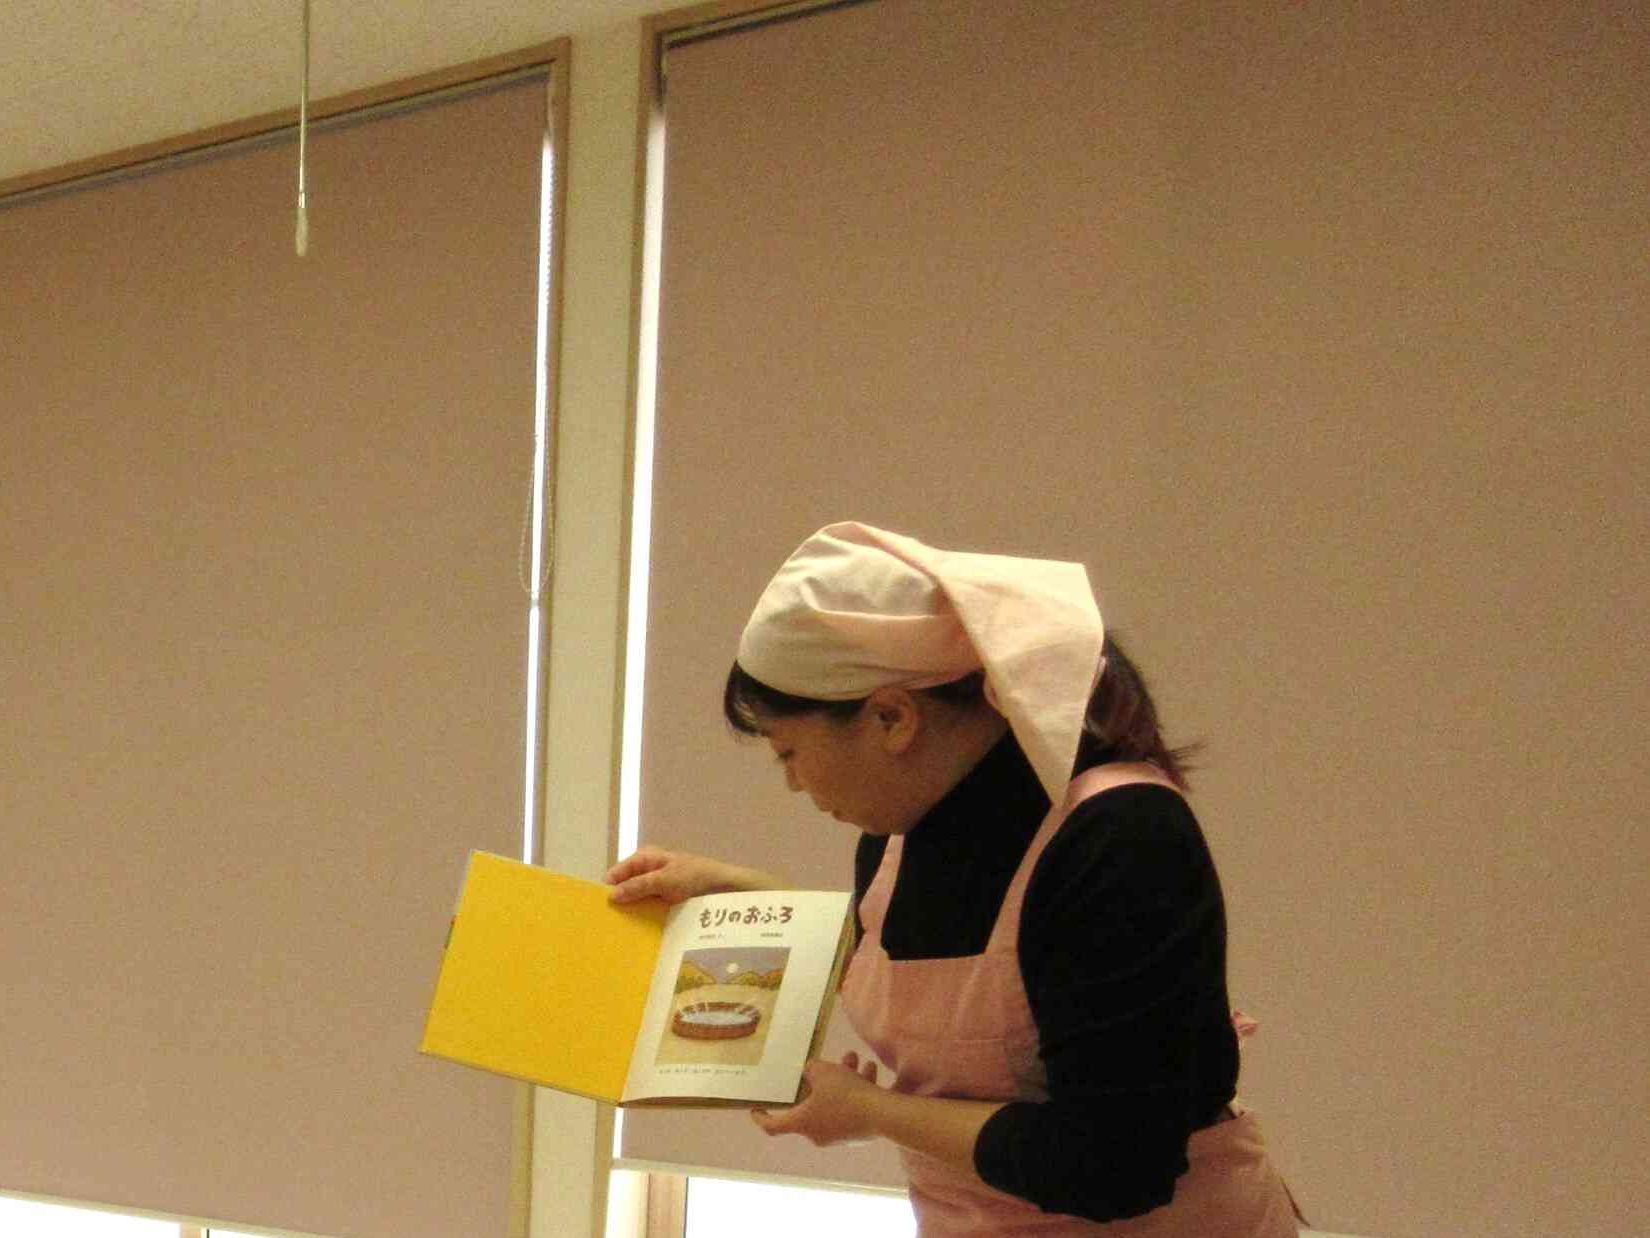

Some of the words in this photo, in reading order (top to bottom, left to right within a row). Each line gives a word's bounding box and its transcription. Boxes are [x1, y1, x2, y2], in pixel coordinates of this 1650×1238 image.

[699, 905, 794, 928] もりのおふろ
